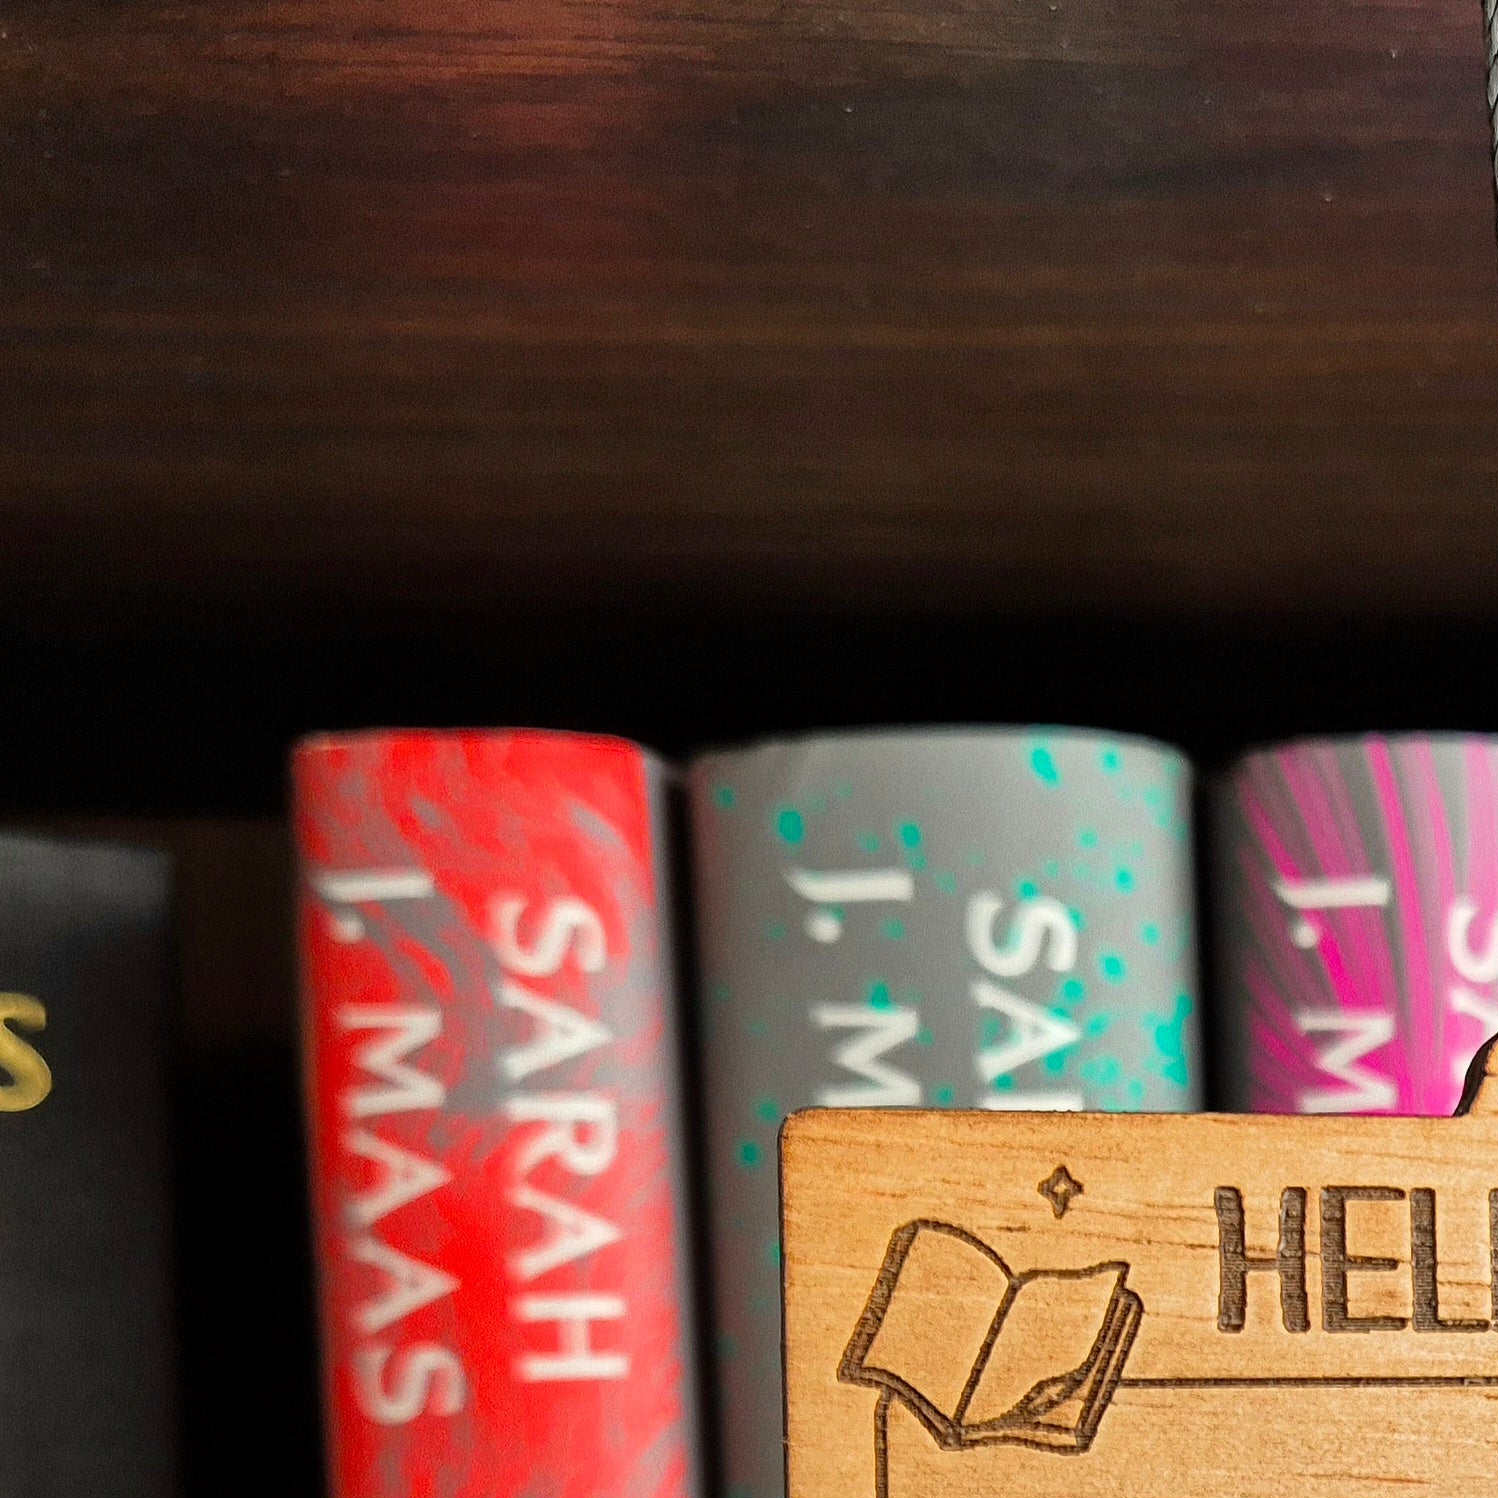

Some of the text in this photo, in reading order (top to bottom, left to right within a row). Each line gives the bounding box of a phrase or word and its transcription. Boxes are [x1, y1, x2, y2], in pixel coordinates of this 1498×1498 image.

[488, 897, 632, 1382] SARAH
[965, 890, 1084, 1111] SA
[337, 1005, 468, 1428] MAAS
